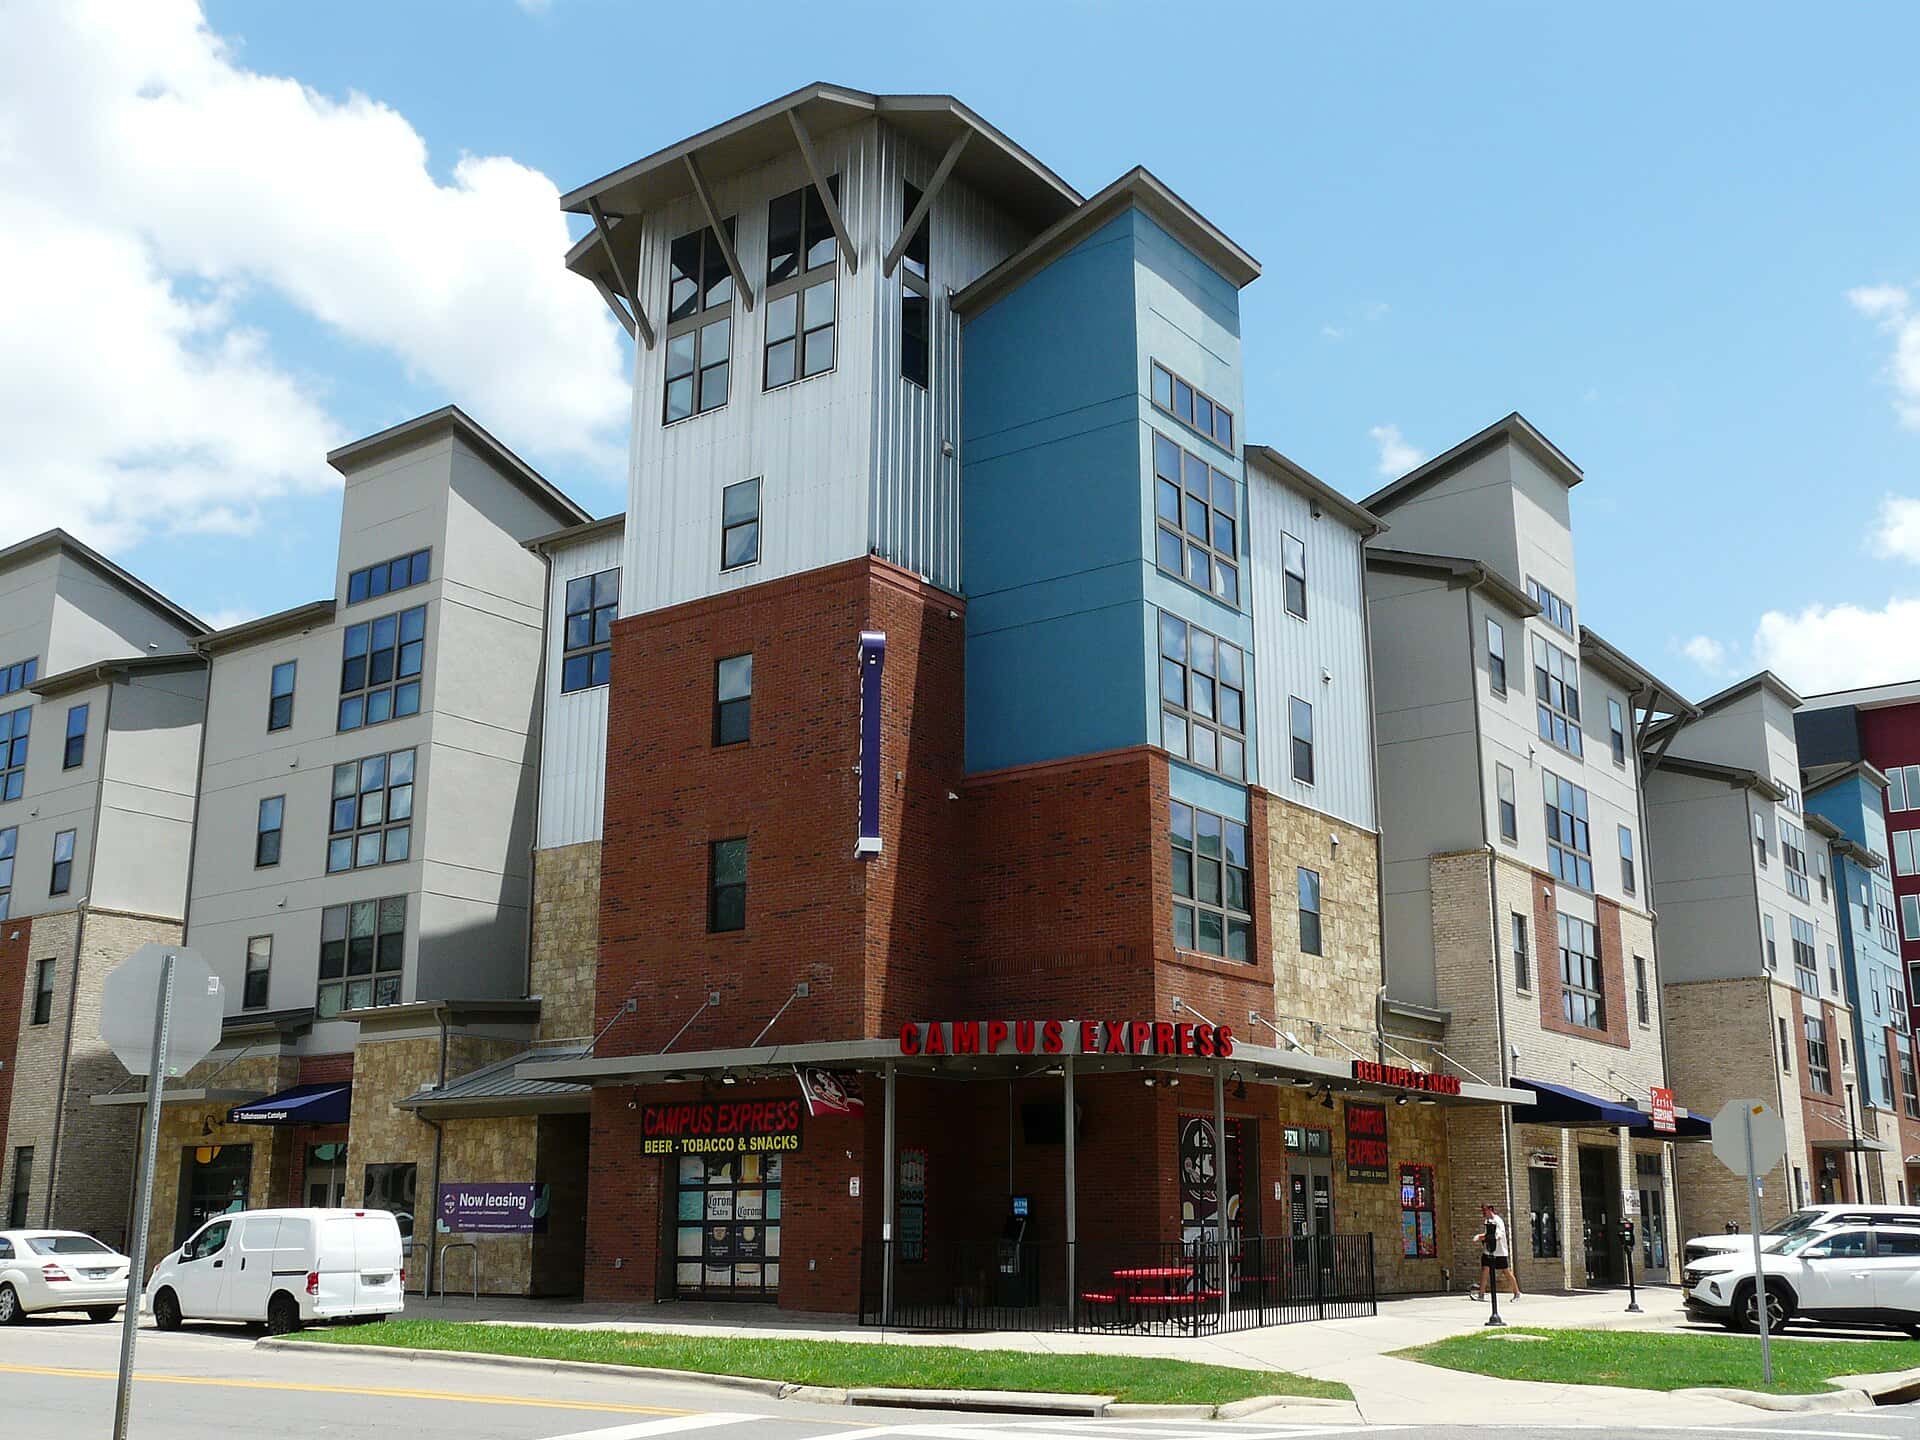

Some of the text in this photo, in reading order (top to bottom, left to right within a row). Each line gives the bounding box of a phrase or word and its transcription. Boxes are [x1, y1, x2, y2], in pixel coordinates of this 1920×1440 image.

[900, 1020, 1233, 1057] CAMPUS EXPRESS
[1356, 1060, 1383, 1083] BEER
[1385, 1065, 1416, 1088] VAPES
[1427, 1072, 1461, 1095] SNACKS
[644, 1100, 800, 1136] CAMPUS EXPRESS
[644, 1139, 673, 1154] BEER
[681, 1137, 734, 1153] TOBACCO
[737, 1137, 747, 1151] &
[749, 1135, 799, 1151] SNACKS
[459, 1192, 527, 1210] Now leasing
